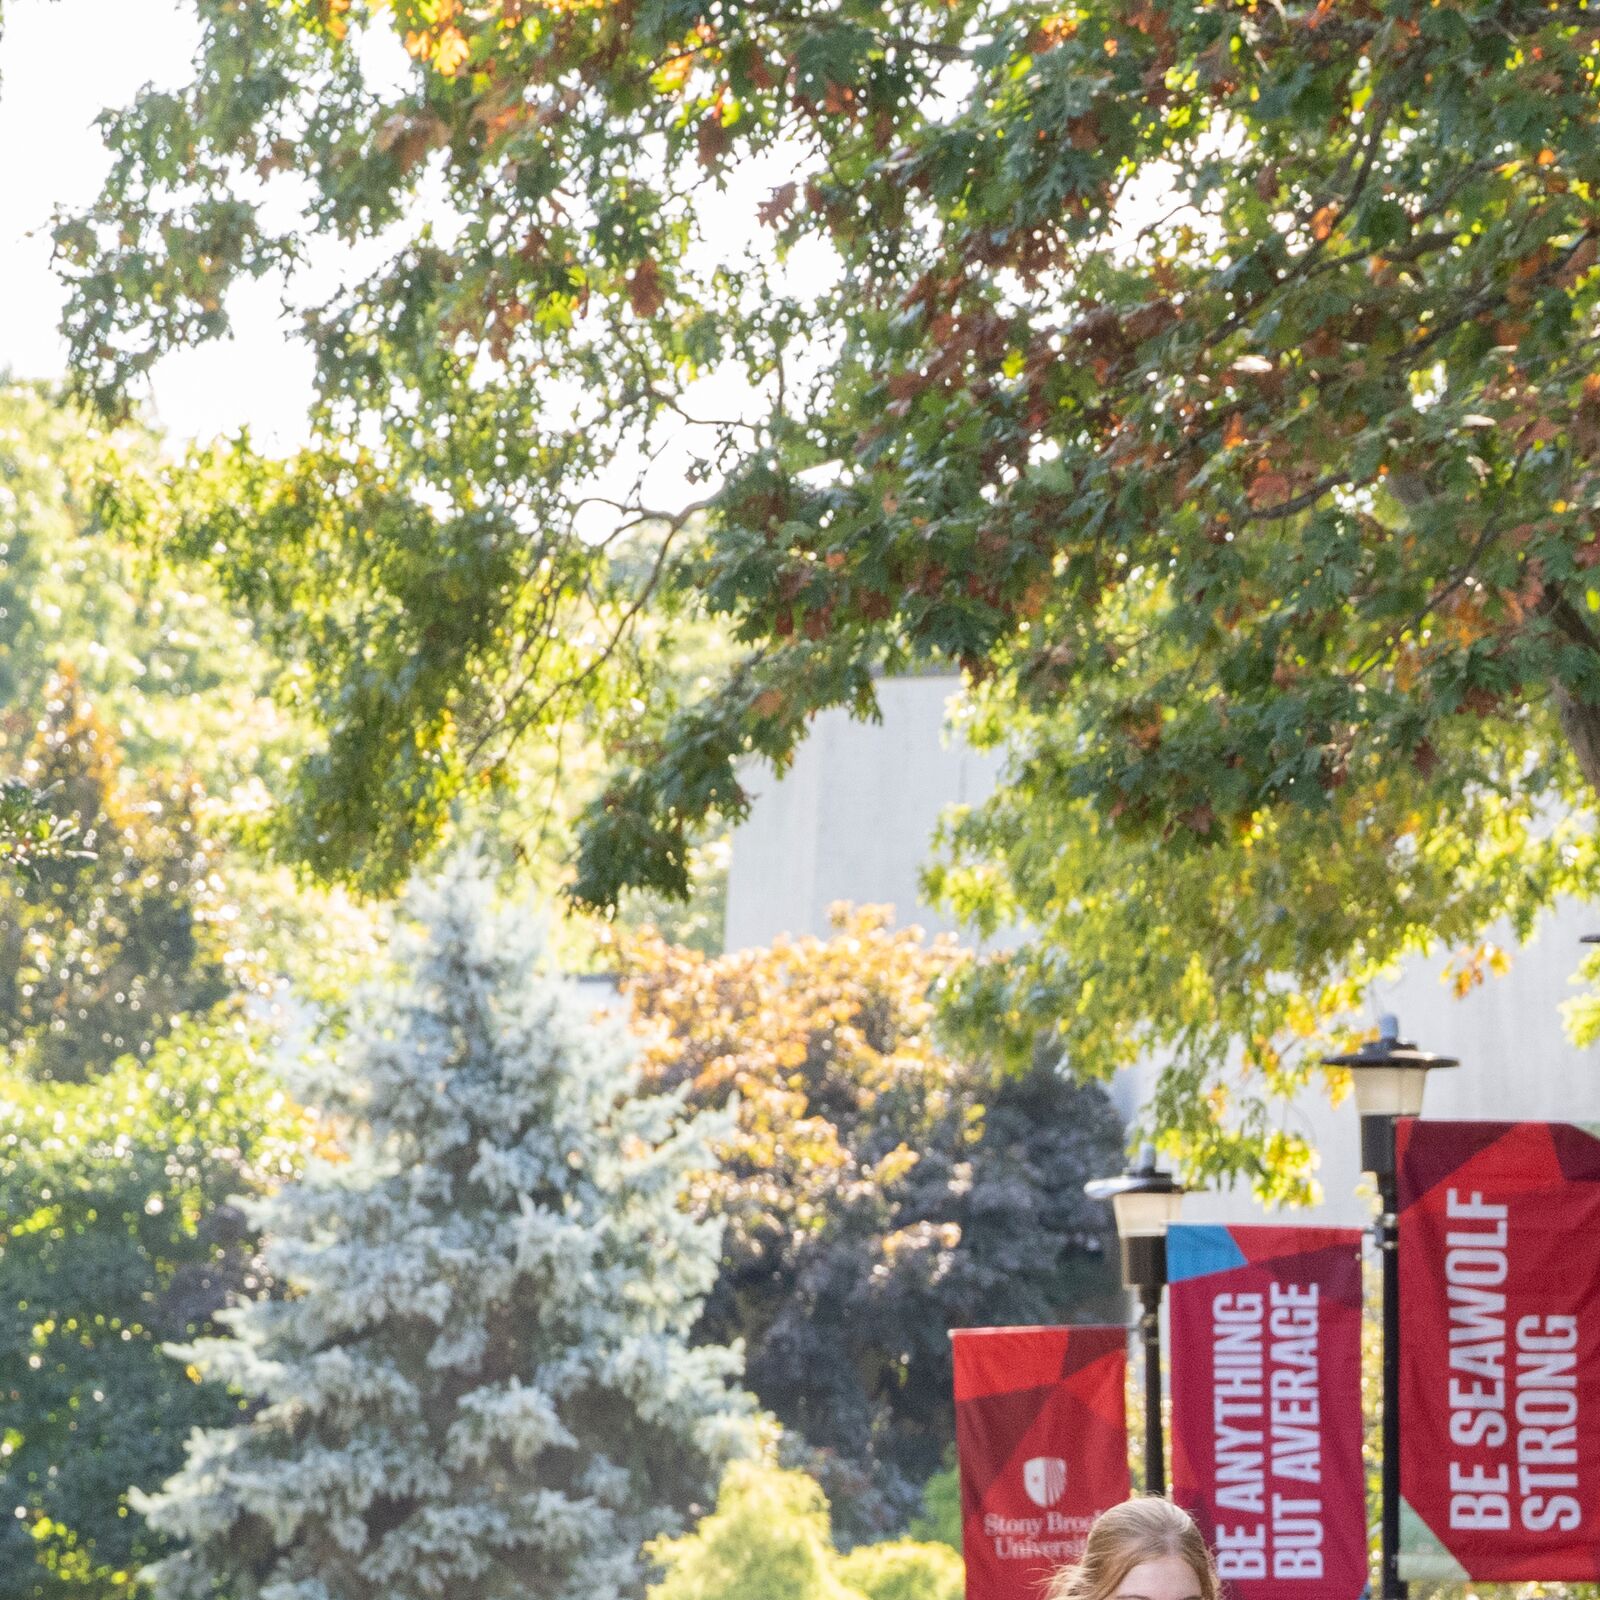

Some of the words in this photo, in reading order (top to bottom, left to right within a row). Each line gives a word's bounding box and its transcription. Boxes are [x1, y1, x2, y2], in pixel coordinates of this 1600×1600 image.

[1269, 1281, 1321, 1483] AVERAGE
[1445, 1188, 1509, 1447] SEAWOLF
[1212, 1293, 1265, 1514] ANYTHING
[1515, 1314, 1582, 1532] STRONG
[984, 1512, 1043, 1537] Stony
[1046, 1510, 1104, 1535] Broo
[1216, 1524, 1266, 1579] BE
[1271, 1493, 1324, 1579] BUT
[1449, 1461, 1511, 1530] BE
